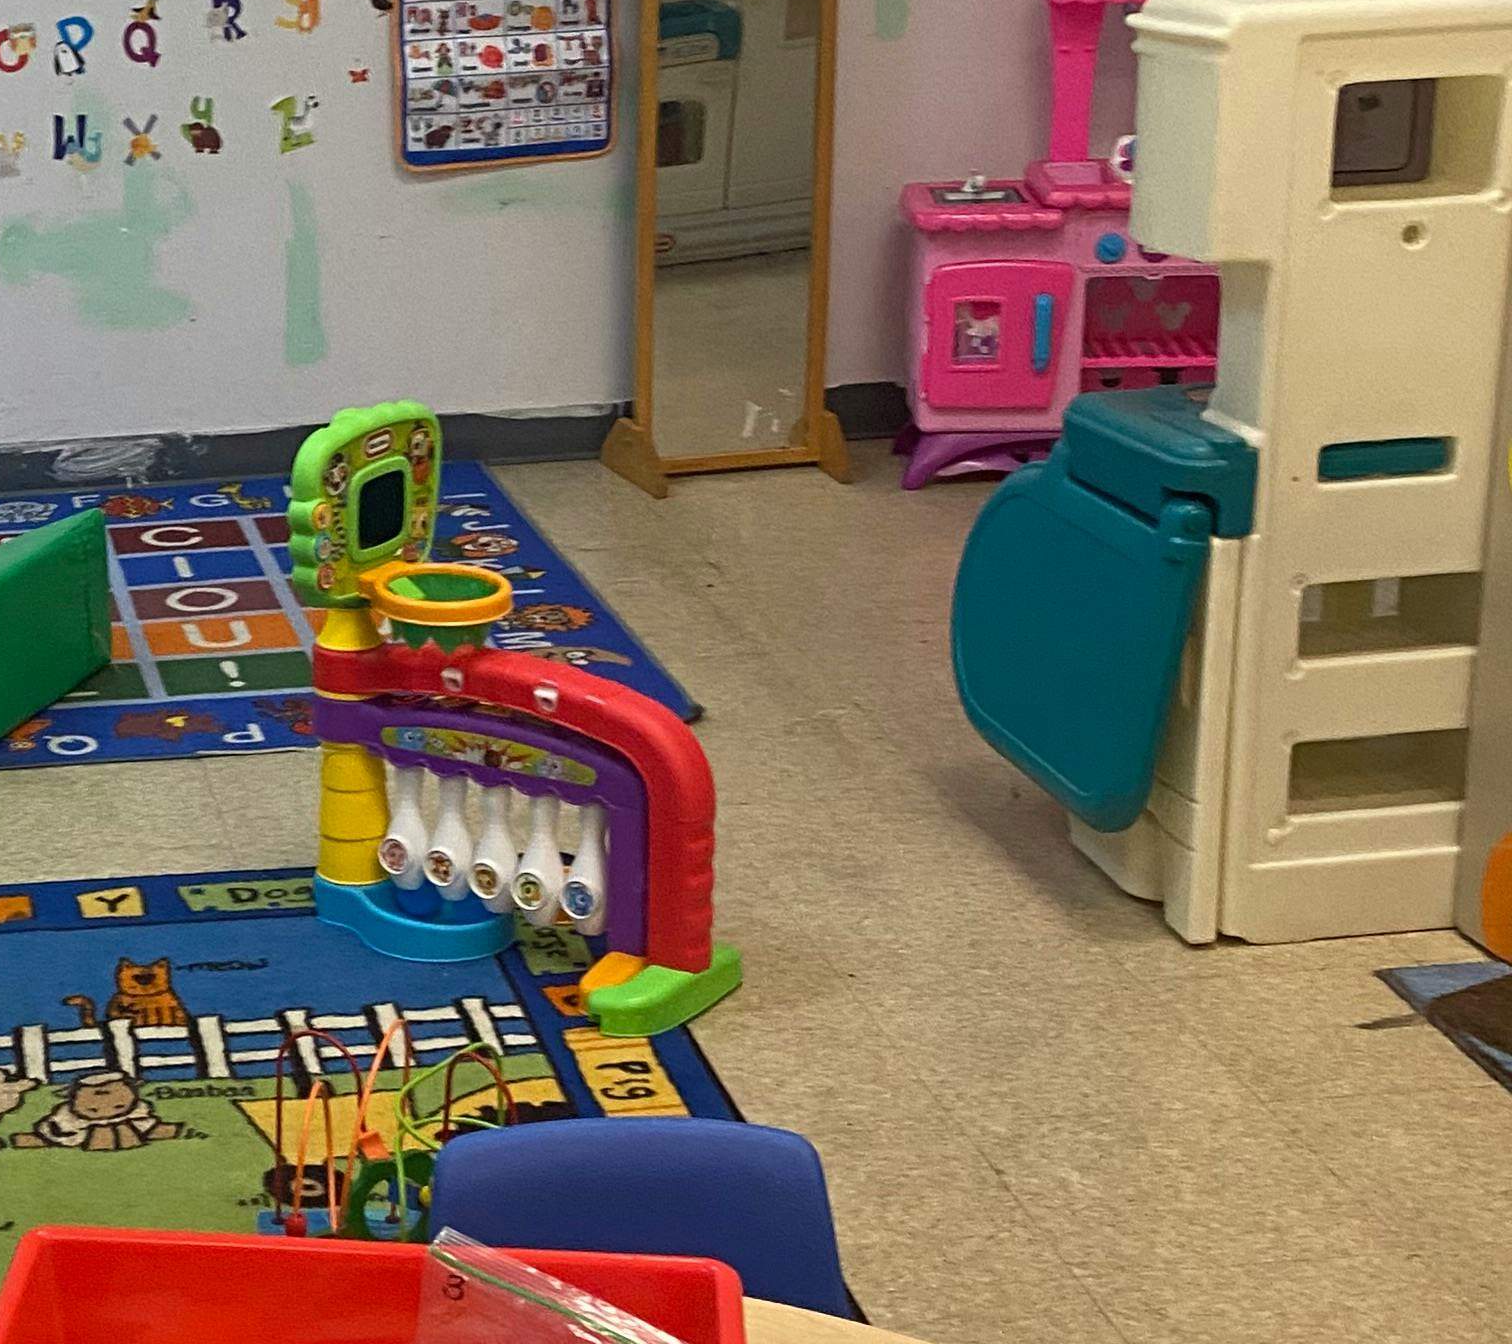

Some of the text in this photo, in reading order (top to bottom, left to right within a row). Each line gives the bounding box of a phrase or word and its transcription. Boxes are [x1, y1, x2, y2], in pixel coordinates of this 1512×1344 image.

[123, 20, 162, 68] Q
[71, 493, 101, 508] F
[189, 493, 230, 508] G
[140, 525, 205, 548] C
[165, 586, 239, 612] O
[180, 620, 253, 649] U
[42, 734, 99, 756] Q
[94, 893, 130, 913] Y
[595, 1060, 656, 1100] Pig
